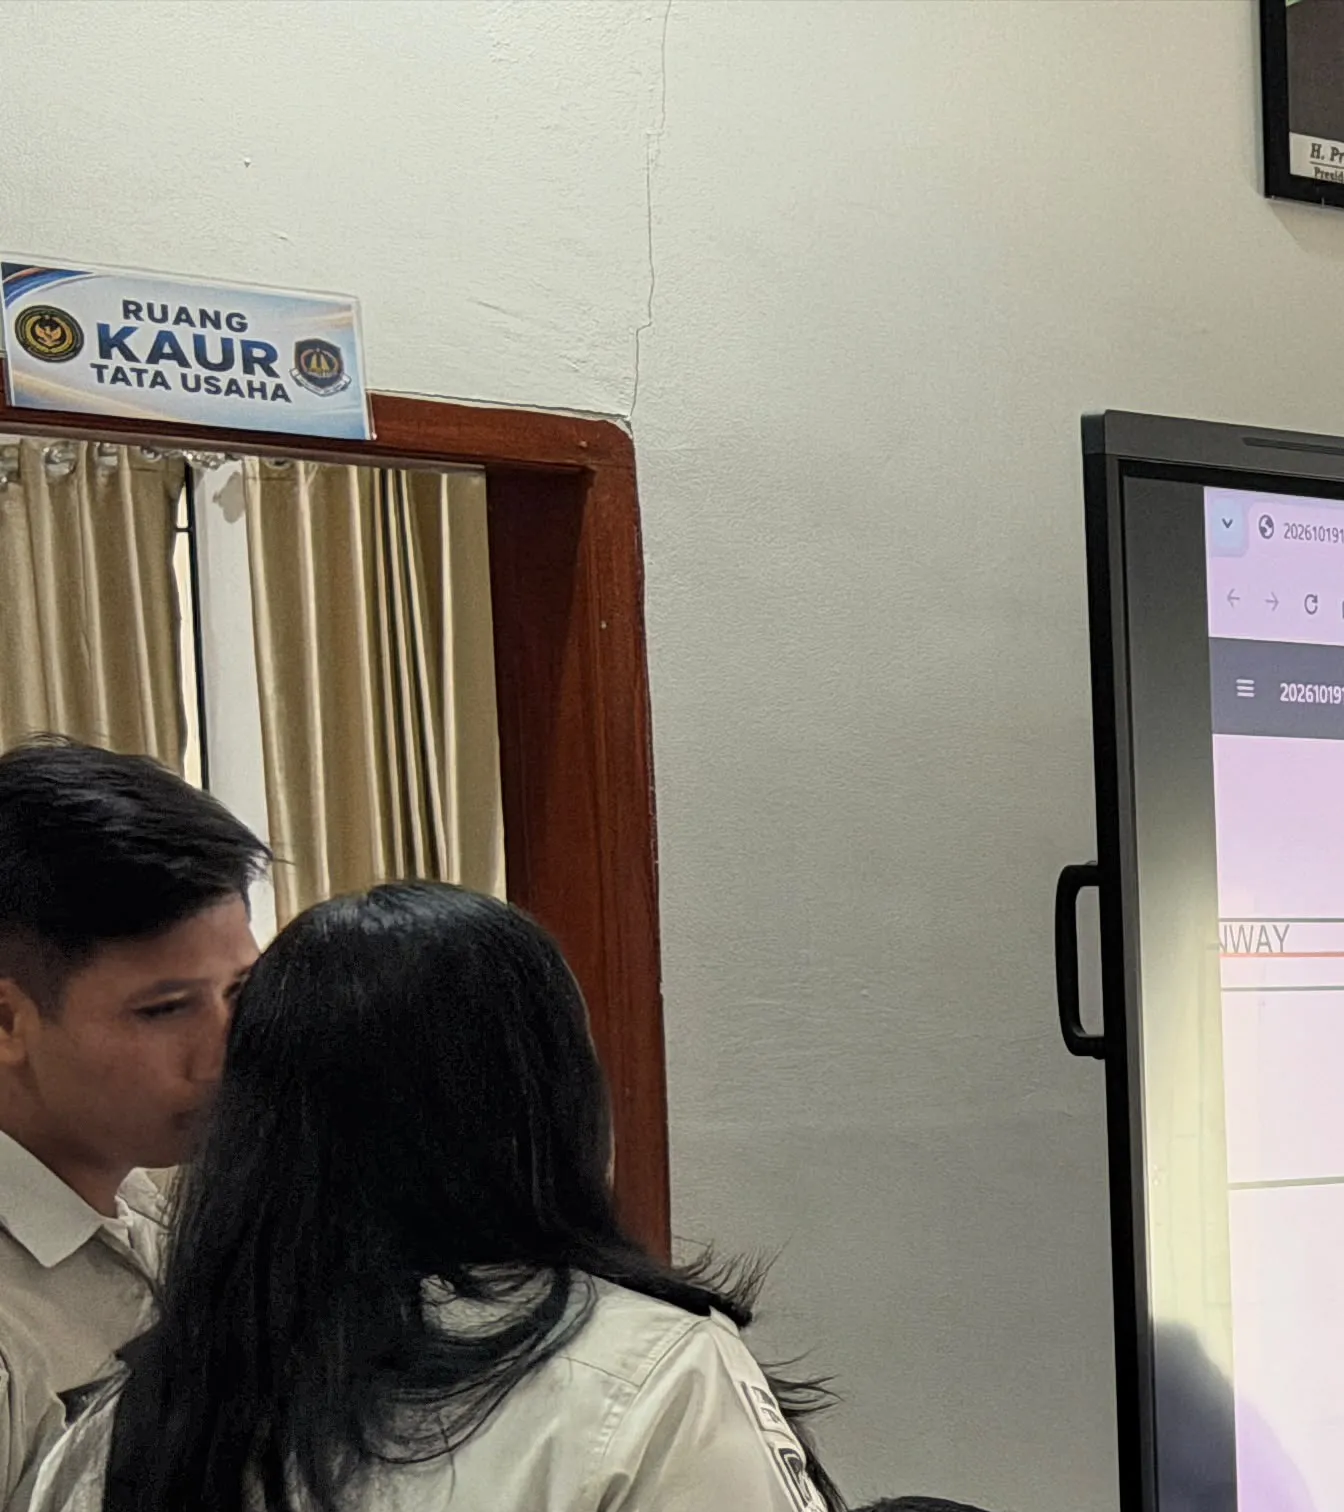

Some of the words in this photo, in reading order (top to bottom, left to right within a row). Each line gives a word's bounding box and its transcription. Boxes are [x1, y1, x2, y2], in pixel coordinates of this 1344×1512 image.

[1310, 143, 1326, 161] H.
[122, 299, 249, 333] RUANG
[96, 322, 281, 378] KAUR
[90, 362, 172, 391] TATA
[181, 373, 292, 403] USAHA
